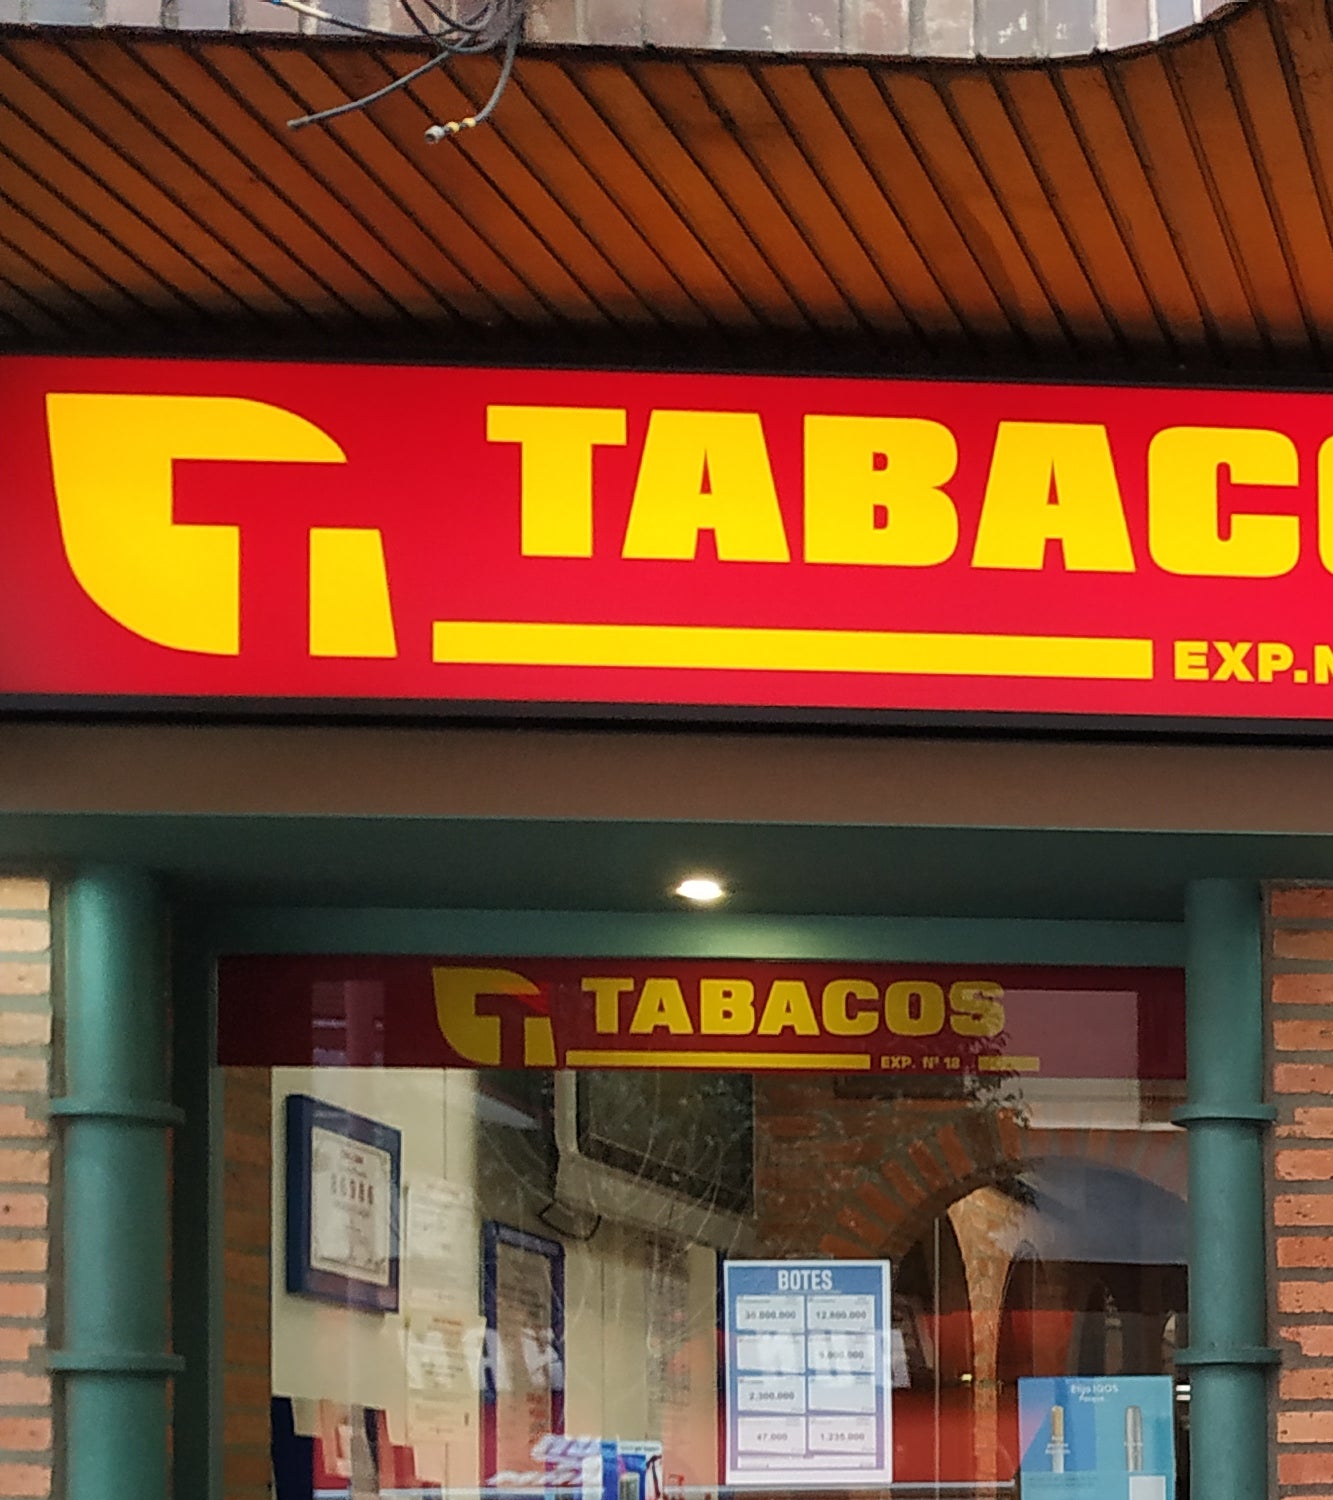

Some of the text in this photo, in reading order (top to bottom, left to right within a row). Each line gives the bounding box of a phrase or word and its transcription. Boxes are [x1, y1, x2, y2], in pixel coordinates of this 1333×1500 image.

[581, 977, 1005, 1038] TABACOS
[944, 1055, 961, 1070] 18
[777, 1269, 834, 1291] BOTES
